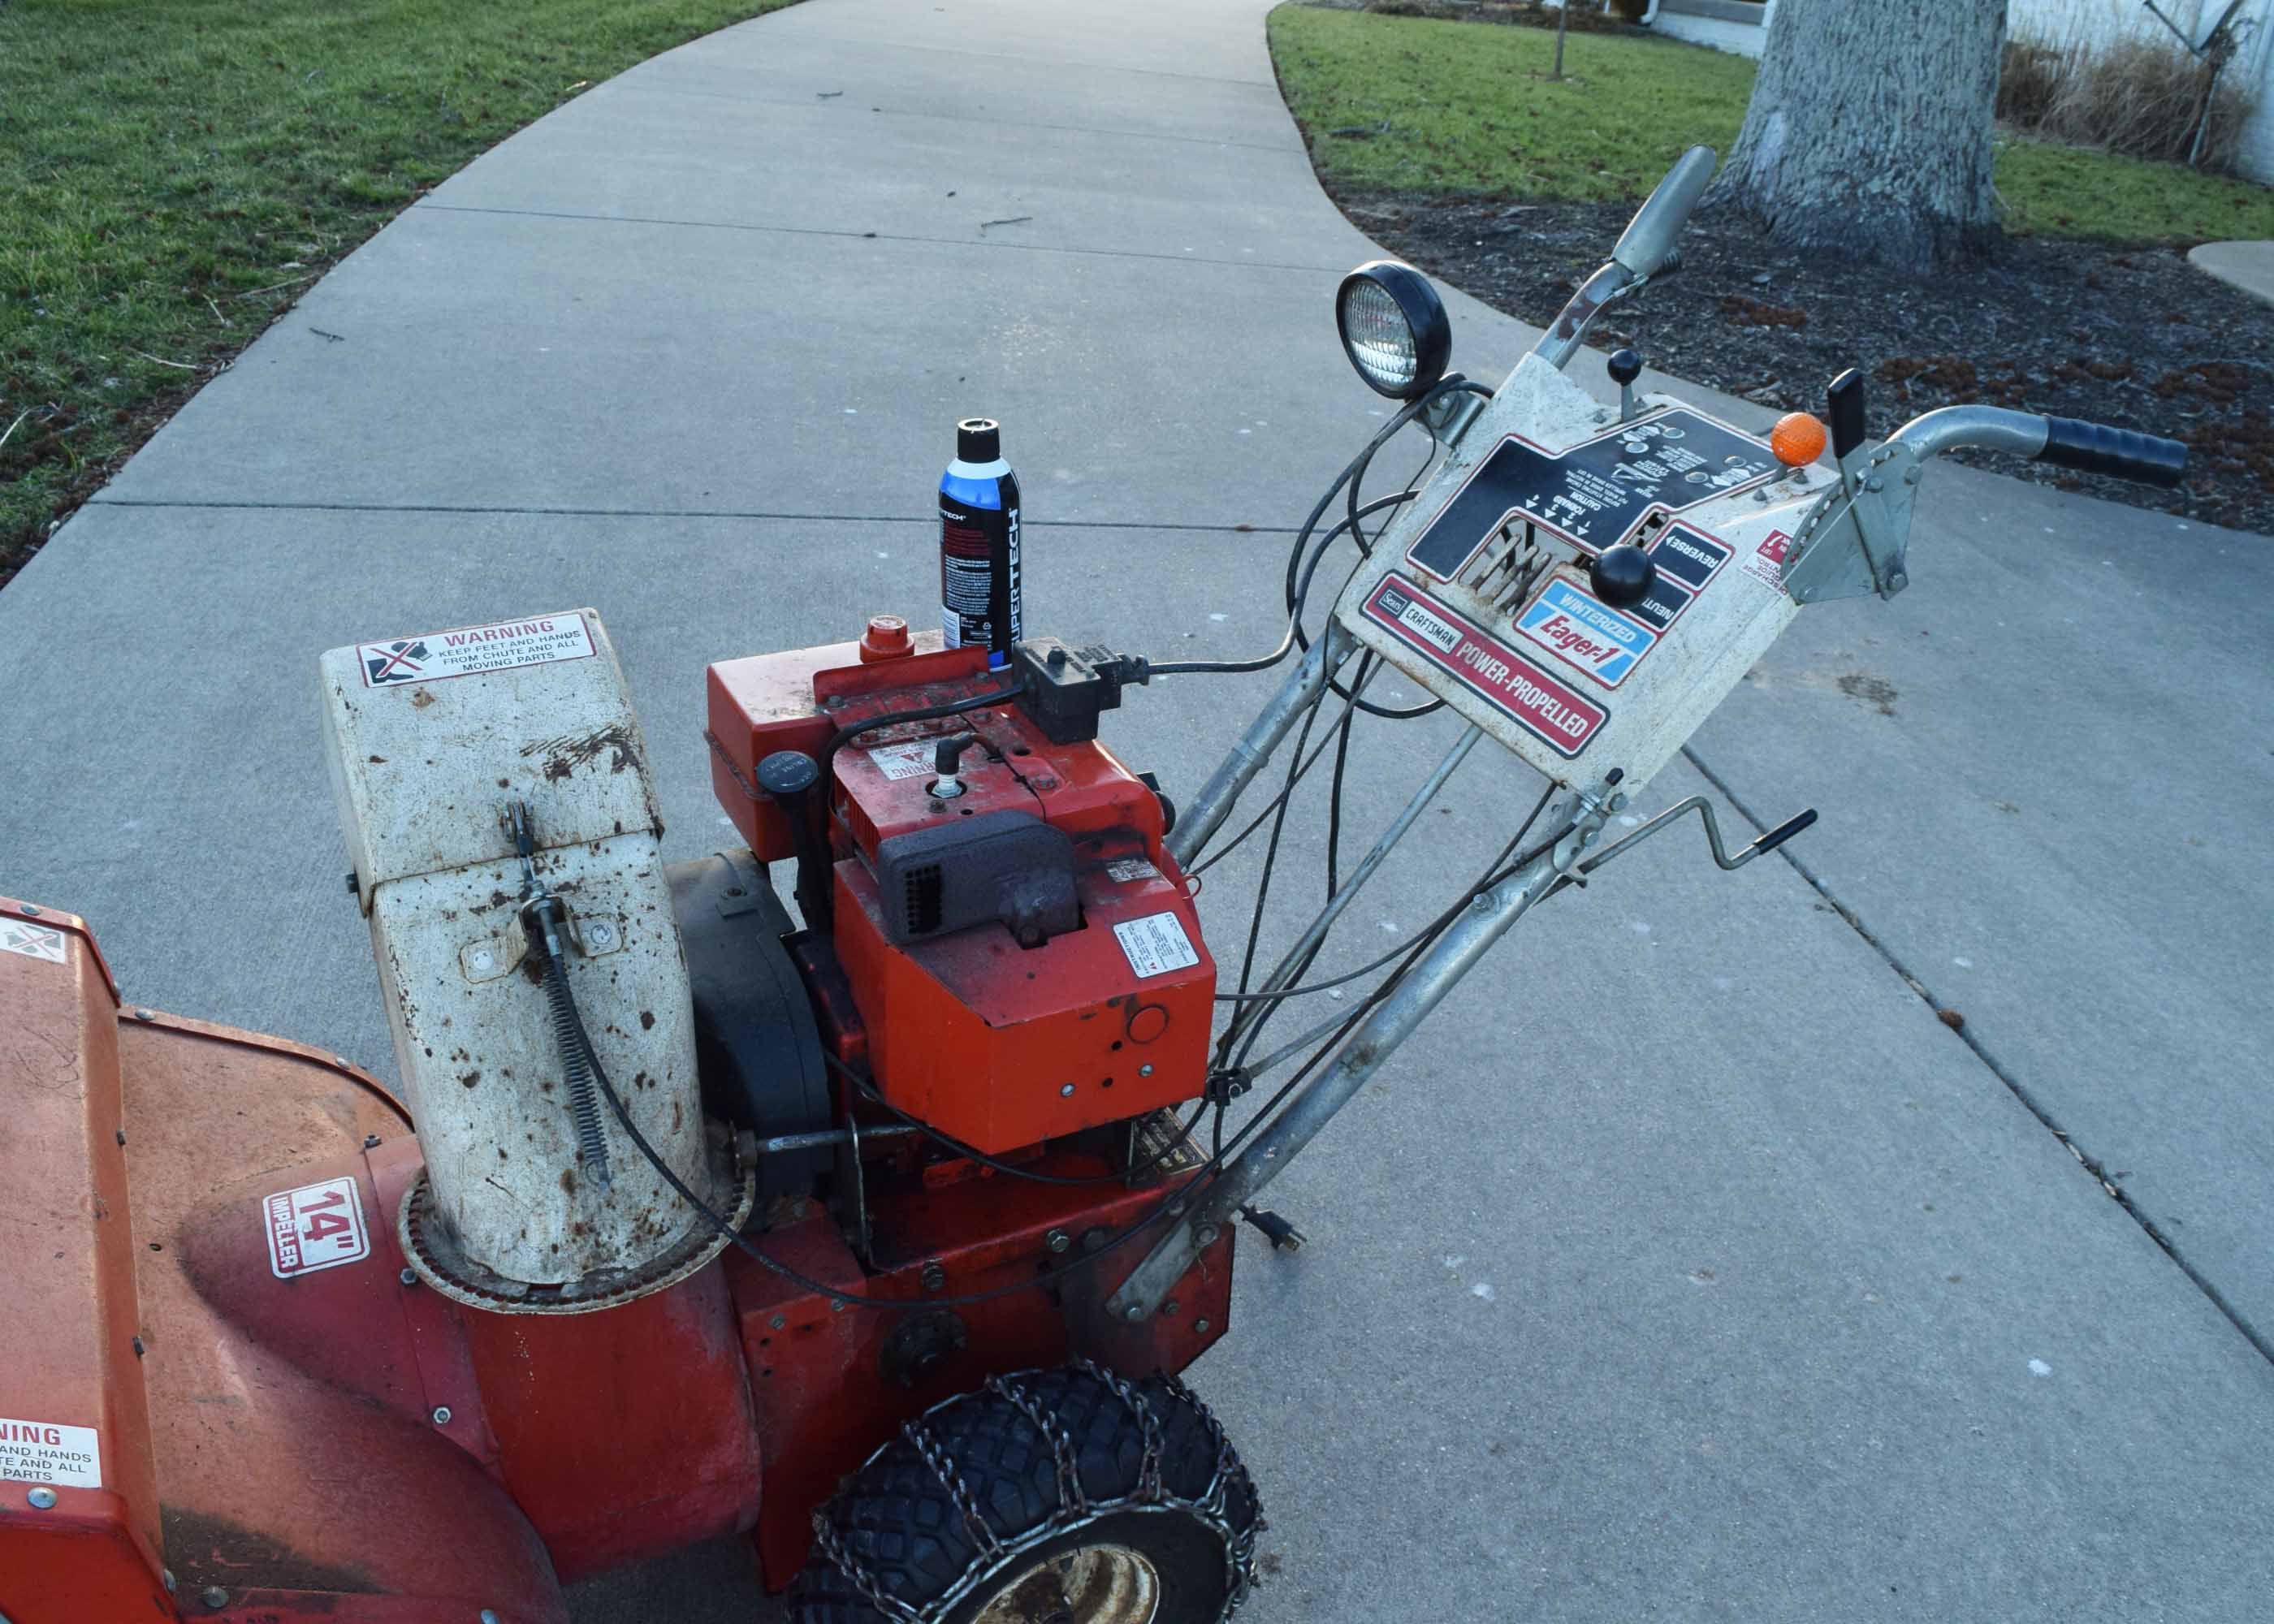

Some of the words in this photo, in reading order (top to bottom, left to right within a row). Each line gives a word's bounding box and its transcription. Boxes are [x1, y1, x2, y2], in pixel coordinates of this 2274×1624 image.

[1553, 495, 1586, 516] FORWARD
[1570, 491, 1602, 511] CAUTION
[1671, 538, 1718, 569] REVERSE
[1560, 593, 1636, 641] WINTERIZED
[1642, 598, 1675, 621] NEUT
[439, 647, 472, 658] KEEP
[474, 642, 506, 654] FEET
[509, 637, 534, 650] AND
[539, 631, 581, 643] HANDS
[445, 620, 555, 646] WARNING
[1540, 615, 1621, 663] Eager-1
[443, 654, 478, 665] FROM
[483, 648, 525, 662] CHUTE
[528, 643, 555, 656] AND
[557, 639, 578, 650] ALL
[463, 658, 513, 671] MOVING
[517, 652, 555, 664] PARTS
[1381, 591, 1406, 611] Sears
[1405, 608, 1455, 646] CRAFTSMAN
[1456, 641, 1589, 738] POWER-PROPELLED
[893, 762, 936, 778] RNING
[271, 1198, 298, 1268] IMPELLER
[0, 1445, 31, 1456] AND
[38, 1449, 91, 1462] HANDS
[2, 1468, 53, 1480] PARTS
[19, 1459, 52, 1469] AND
[58, 1462, 87, 1473] ALL
